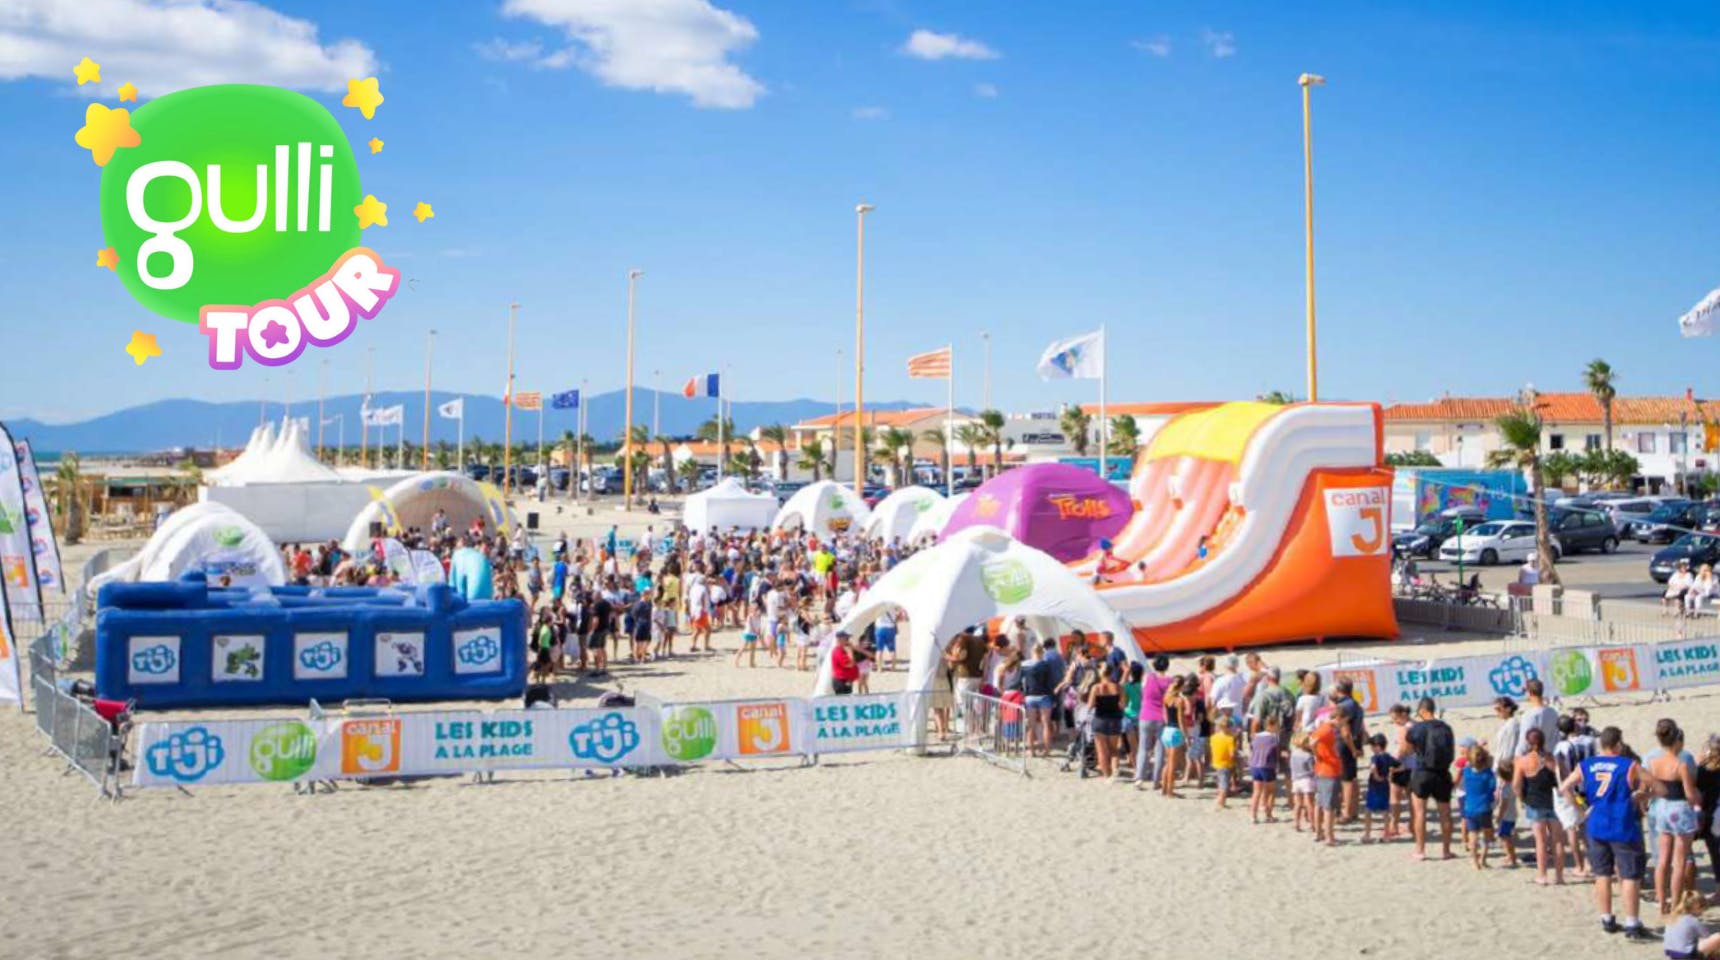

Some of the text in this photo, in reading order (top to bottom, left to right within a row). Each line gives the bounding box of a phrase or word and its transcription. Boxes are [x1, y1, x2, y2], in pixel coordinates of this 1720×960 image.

[1331, 488, 1386, 507] canal
[1351, 507, 1382, 555] J
[1684, 644, 1717, 660] KIDS
[1430, 666, 1464, 682] KIDS
[740, 705, 783, 719] canal
[815, 702, 896, 721] LES KIDS
[435, 720, 533, 740] LES KIDS
[668, 717, 714, 754] gulli
[752, 719, 783, 750] J
[831, 726, 852, 738] LA
[855, 722, 900, 737] PLAGE
[253, 734, 314, 773] gulli
[357, 734, 393, 770] J
[453, 745, 474, 758] LA
[480, 743, 533, 758] PLAGE
[1595, 772, 1613, 797] 7
